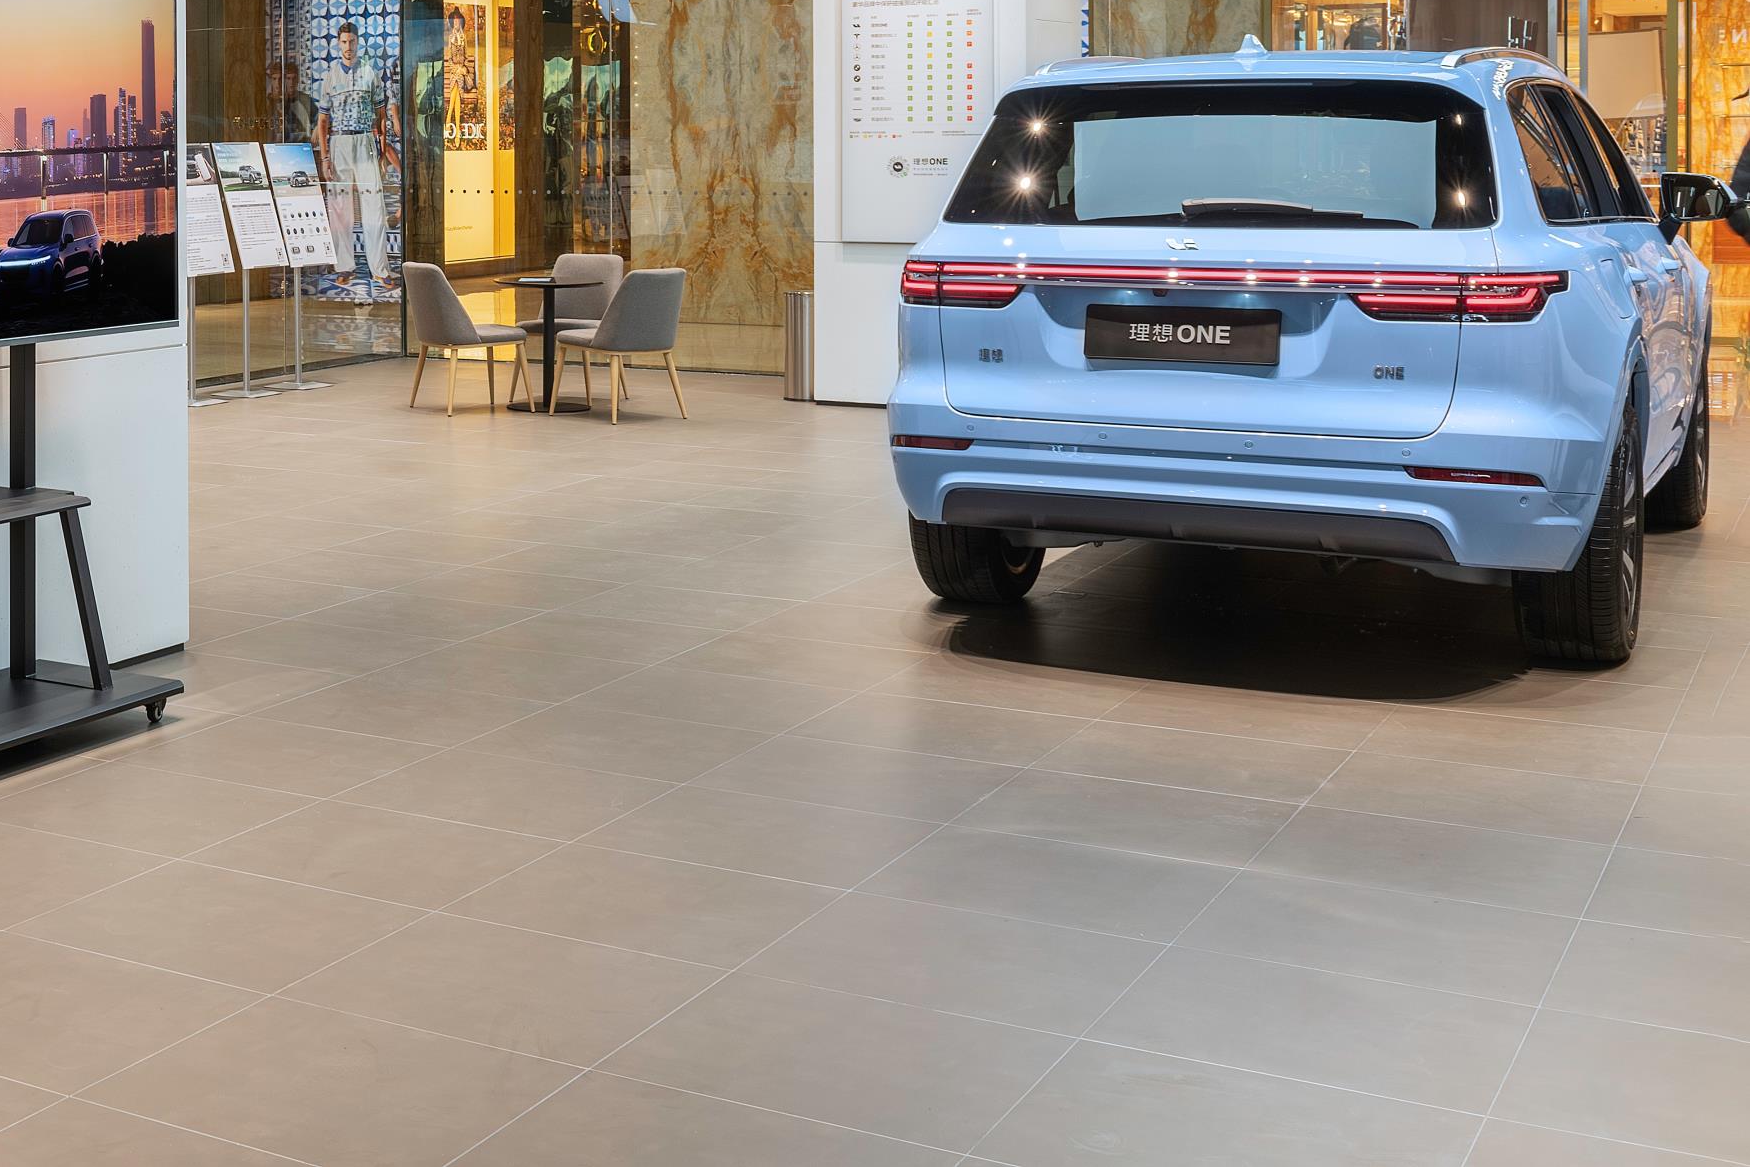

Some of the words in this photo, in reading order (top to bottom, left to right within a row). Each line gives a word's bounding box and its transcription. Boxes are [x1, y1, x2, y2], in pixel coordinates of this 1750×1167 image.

[913, 157, 949, 166] 理想ONE
[1129, 323, 1231, 345] 理想ONE
[978, 348, 1004, 363] 理想
[1372, 364, 1406, 381] ONE
